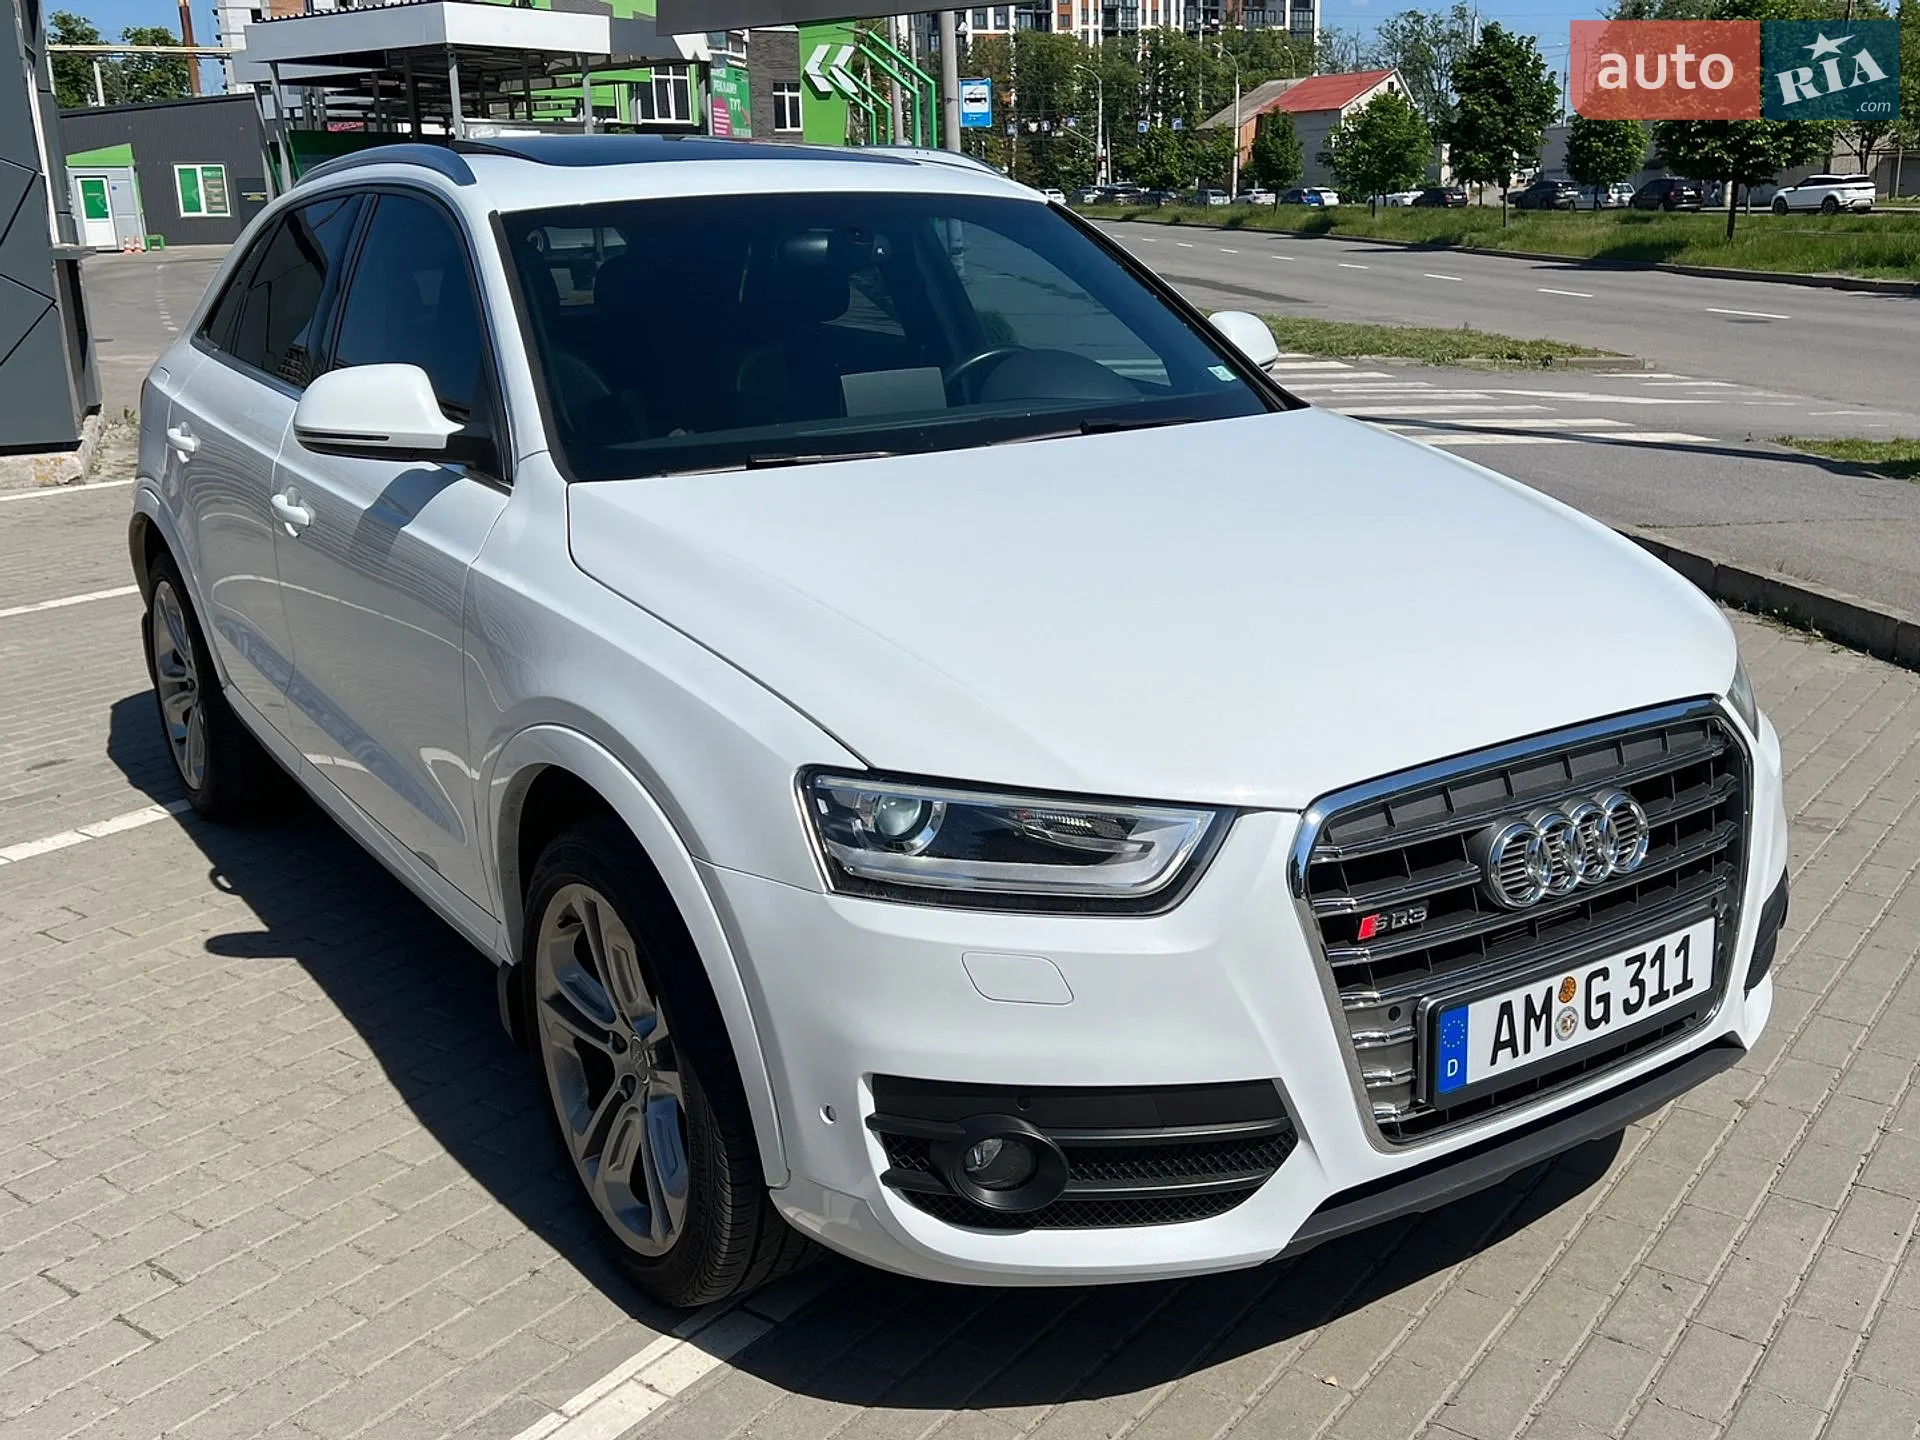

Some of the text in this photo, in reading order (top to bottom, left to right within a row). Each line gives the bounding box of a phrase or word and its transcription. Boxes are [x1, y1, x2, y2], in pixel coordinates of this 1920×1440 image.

[1490, 934, 1693, 1066] AM G 311
[1447, 1058, 1459, 1077] D
